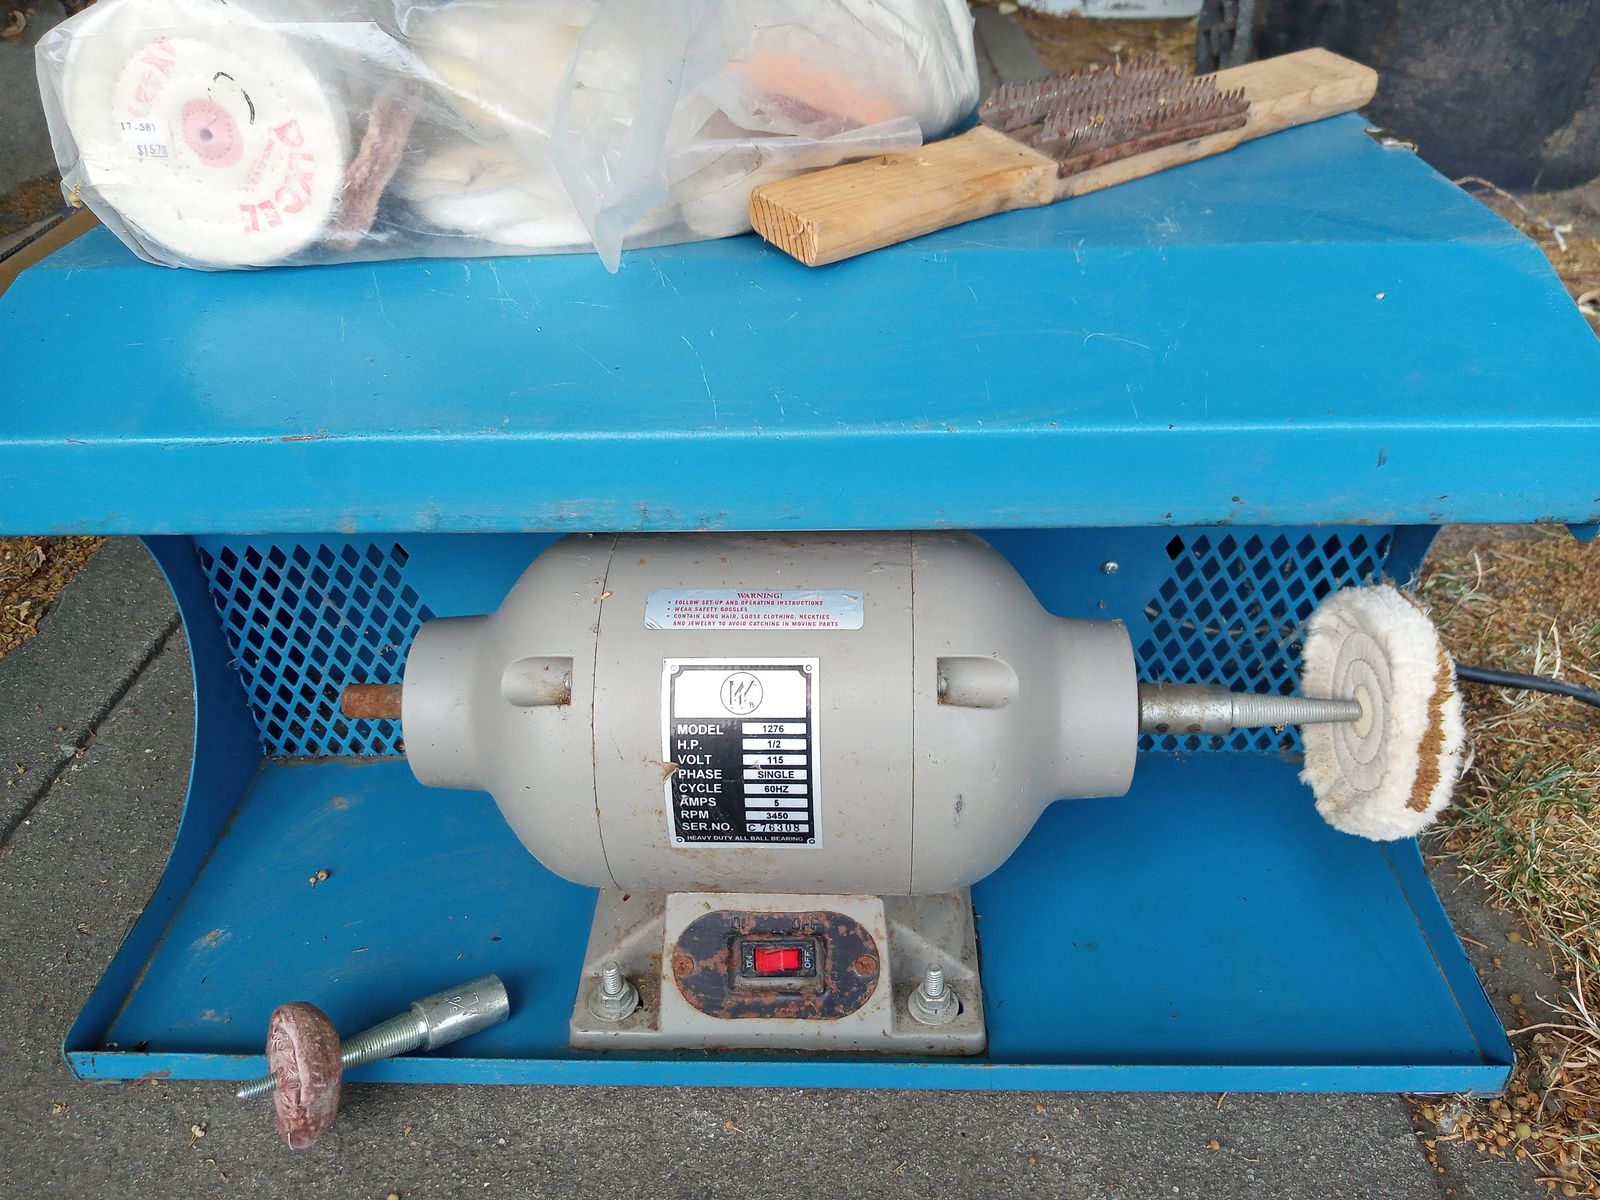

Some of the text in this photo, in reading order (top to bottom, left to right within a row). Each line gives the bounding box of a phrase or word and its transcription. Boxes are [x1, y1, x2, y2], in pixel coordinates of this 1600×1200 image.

[677, 724, 784, 735] MODEL 1276
[678, 740, 781, 750] H.P. 1/2
[678, 755, 712, 764] VOLT
[679, 770, 794, 779] PHASE SINGLE
[679, 784, 722, 793] CYCLE
[680, 797, 716, 807] AMPS
[681, 811, 709, 819] RPM
[683, 823, 734, 831] SER.NO.
[746, 955, 753, 968] ON
